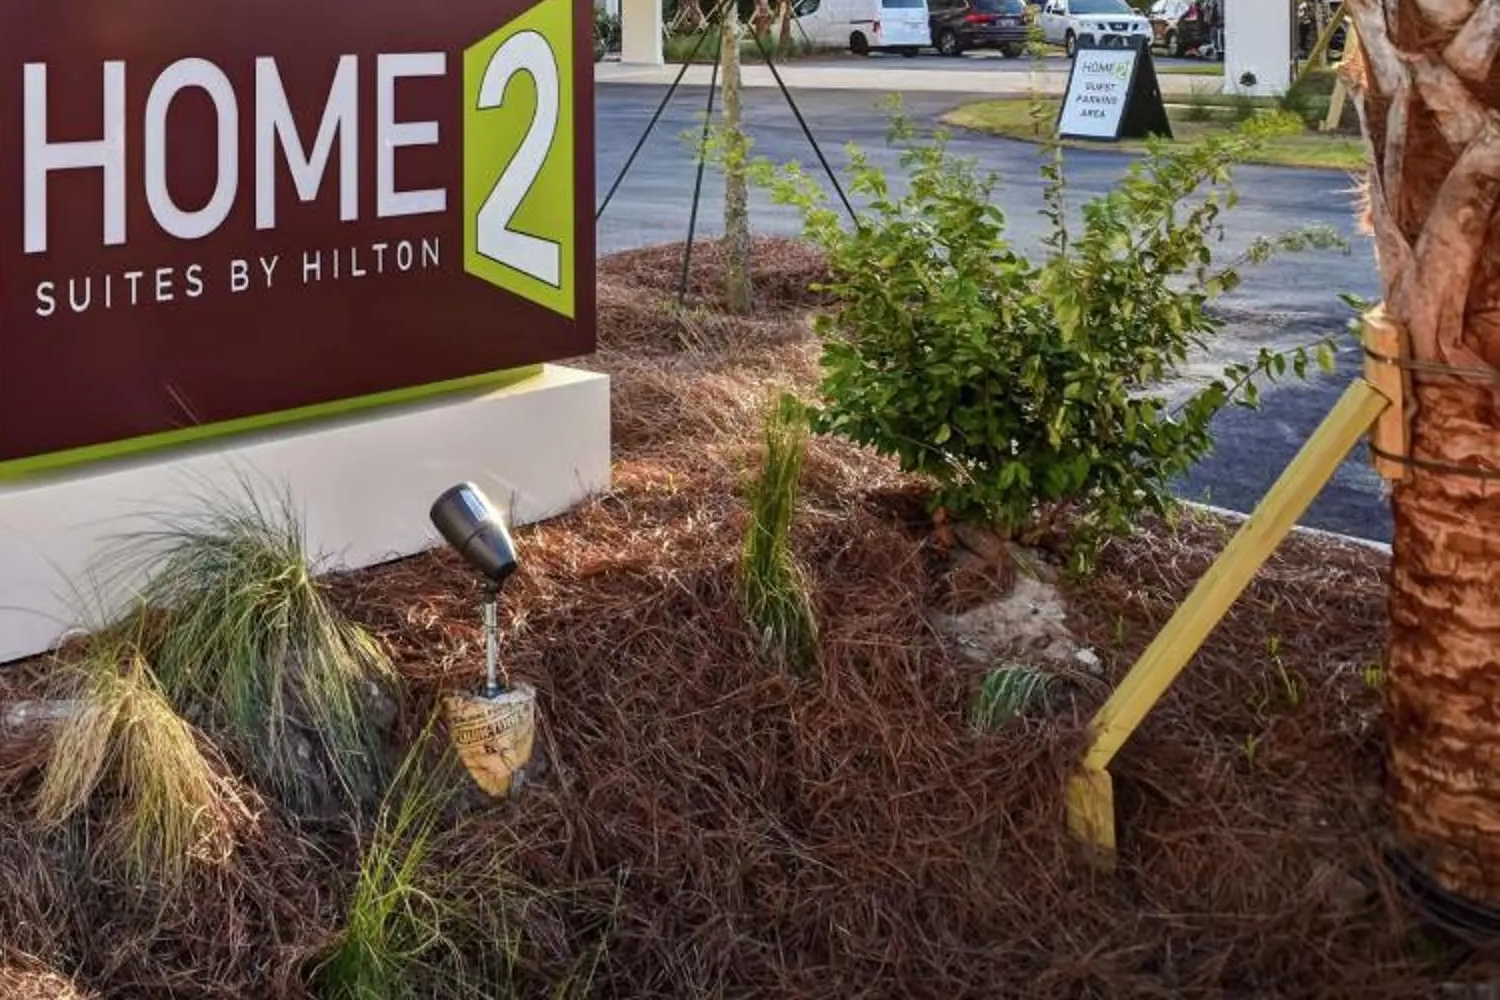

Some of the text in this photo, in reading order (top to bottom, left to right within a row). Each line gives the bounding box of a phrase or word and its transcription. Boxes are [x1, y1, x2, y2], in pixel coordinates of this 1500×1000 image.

[1085, 83, 1116, 91] GUEST
[1076, 95, 1117, 104] PARKING
[1080, 109, 1105, 118] AREA
[36, 237, 440, 316] SUITES BY HILTON
